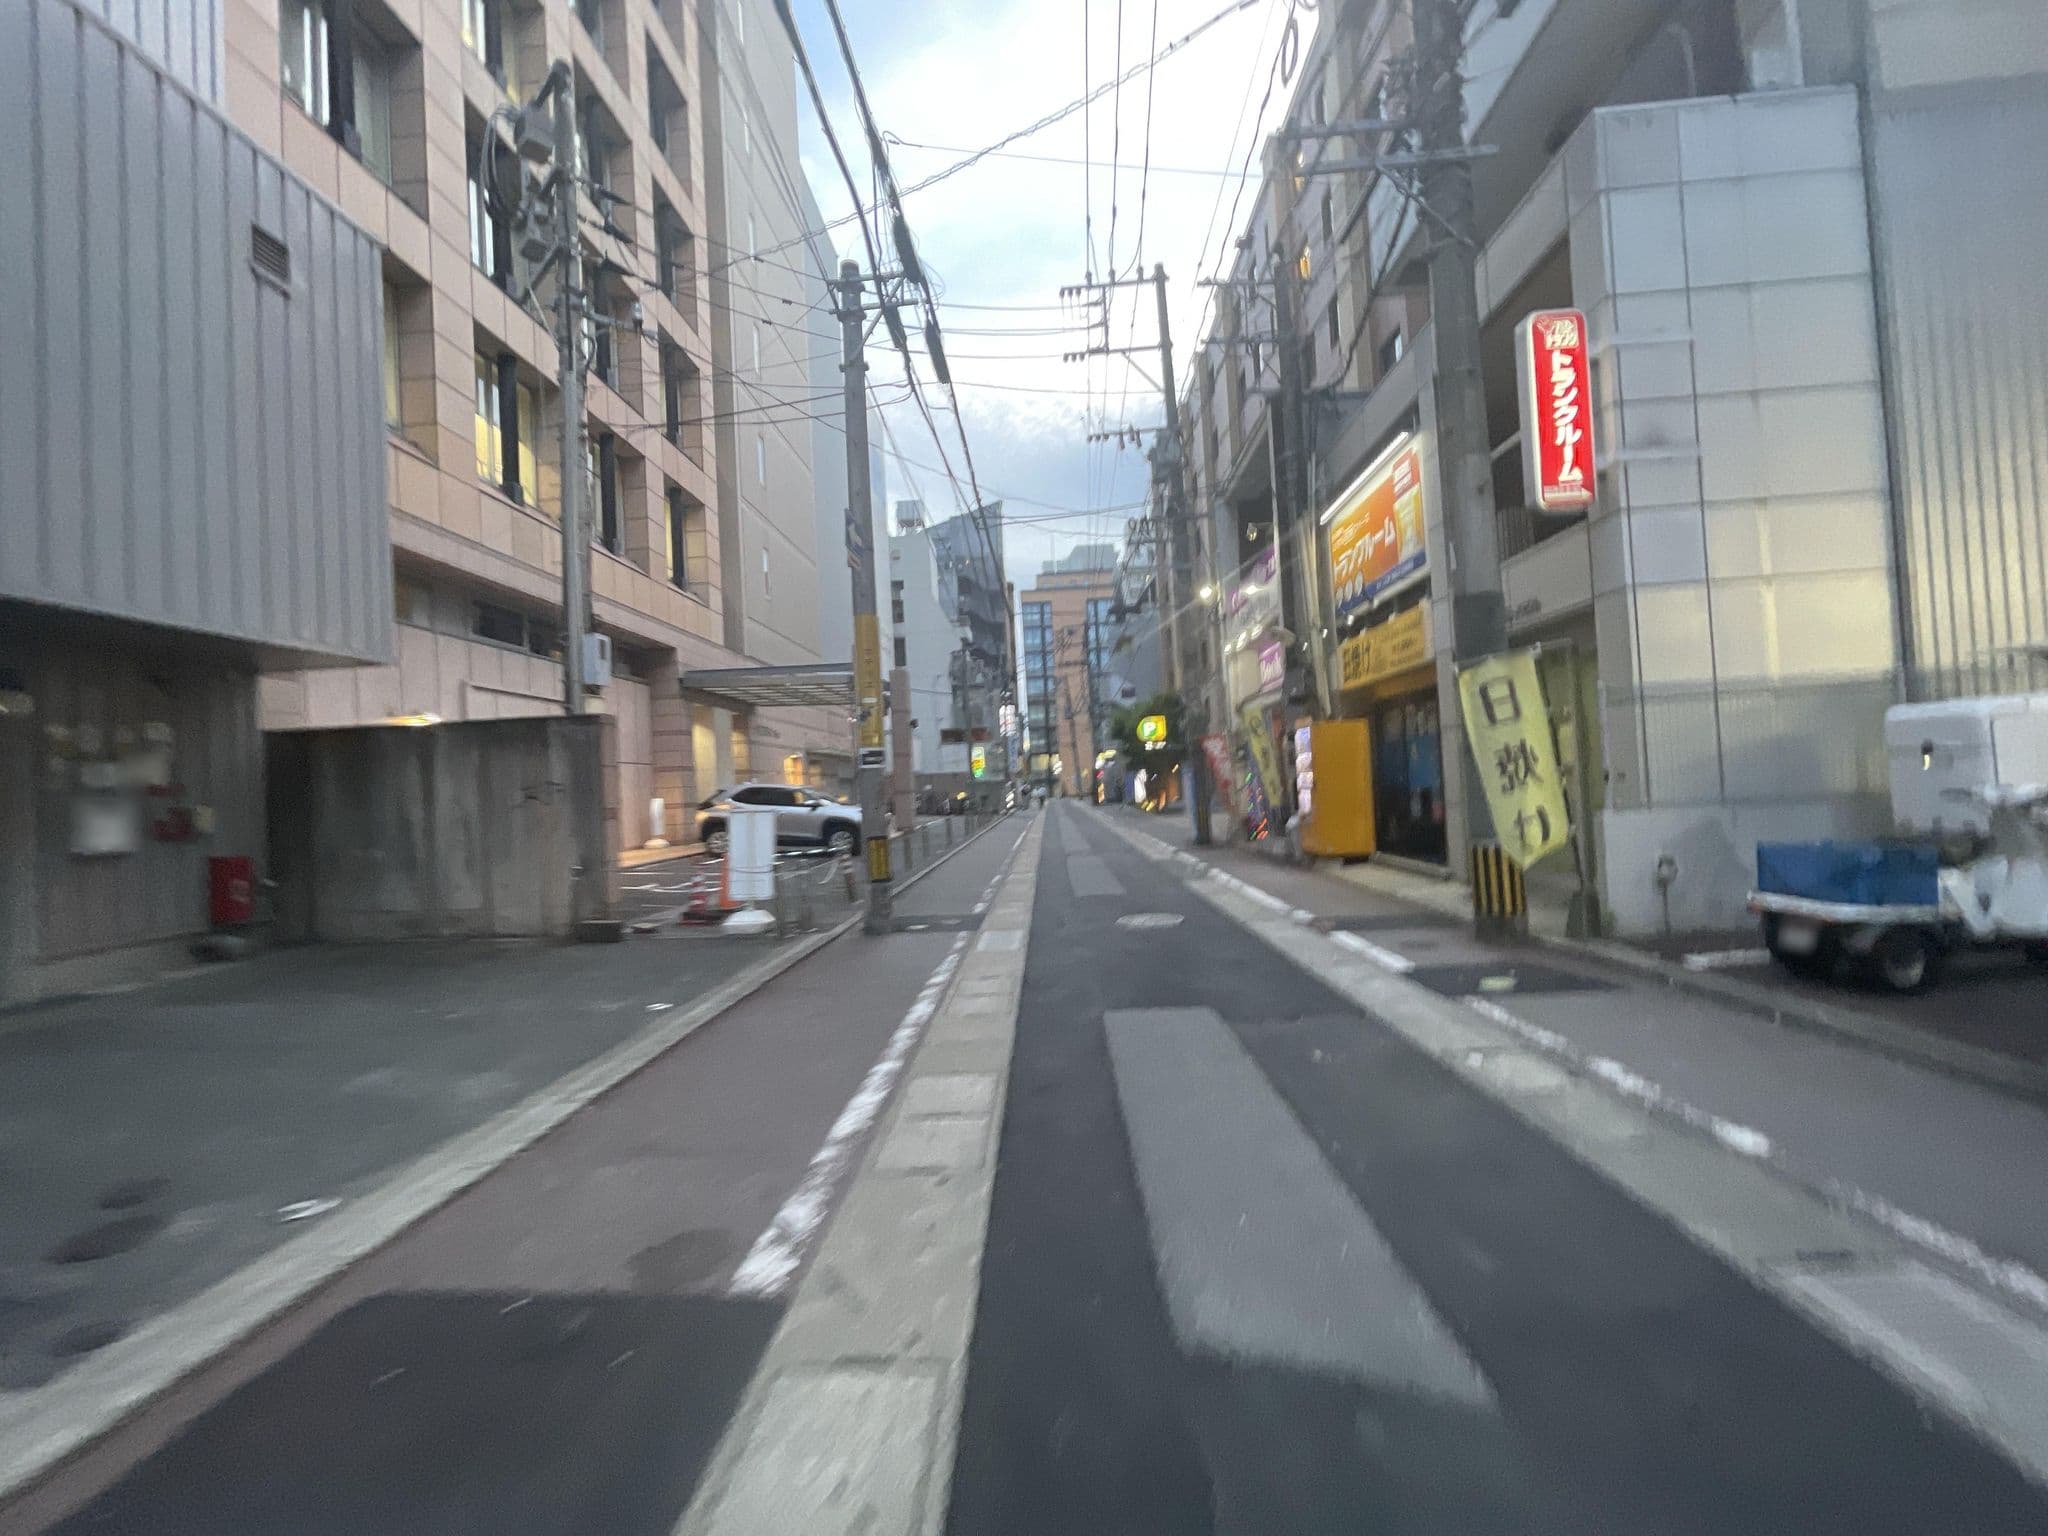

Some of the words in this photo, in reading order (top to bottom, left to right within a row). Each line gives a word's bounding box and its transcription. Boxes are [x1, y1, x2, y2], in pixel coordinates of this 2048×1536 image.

[1551, 350, 1583, 482] トランクルーム
[1333, 516, 1396, 583] トランクルーム
